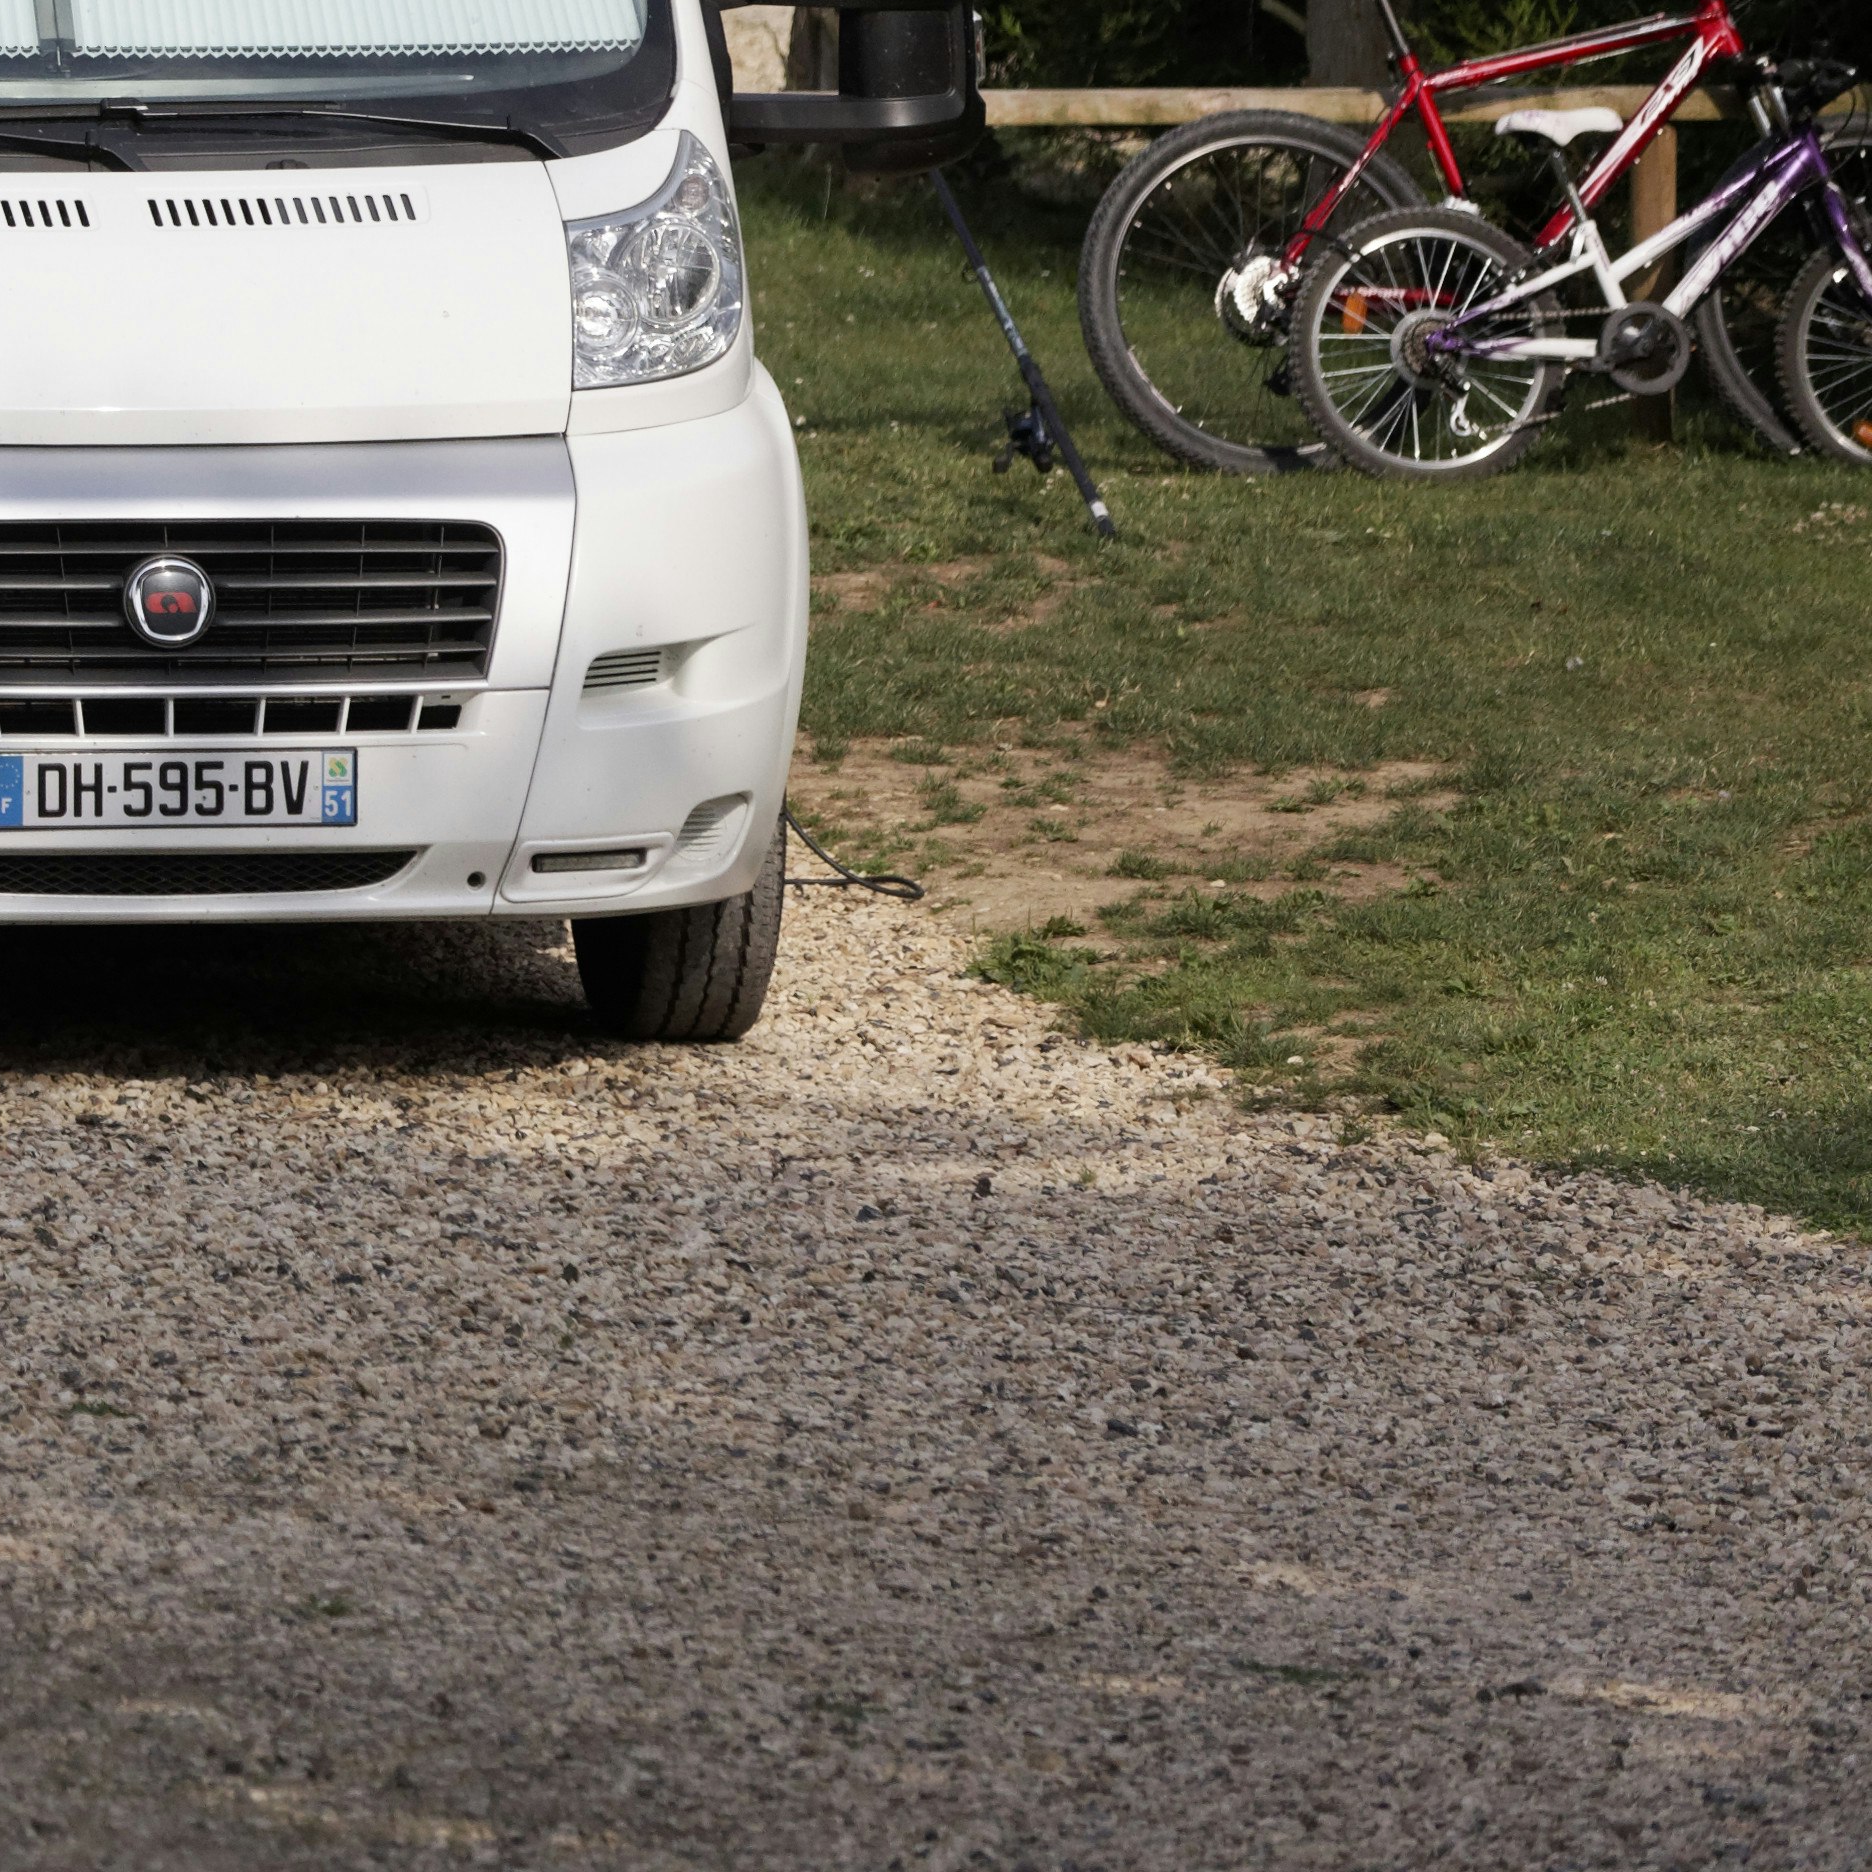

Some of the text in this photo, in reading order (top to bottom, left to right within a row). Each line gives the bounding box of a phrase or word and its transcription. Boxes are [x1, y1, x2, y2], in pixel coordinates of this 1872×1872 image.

[37, 760, 309, 818] DH-595-BV
[324, 789, 352, 817] 51
[0, 797, 13, 815] F
